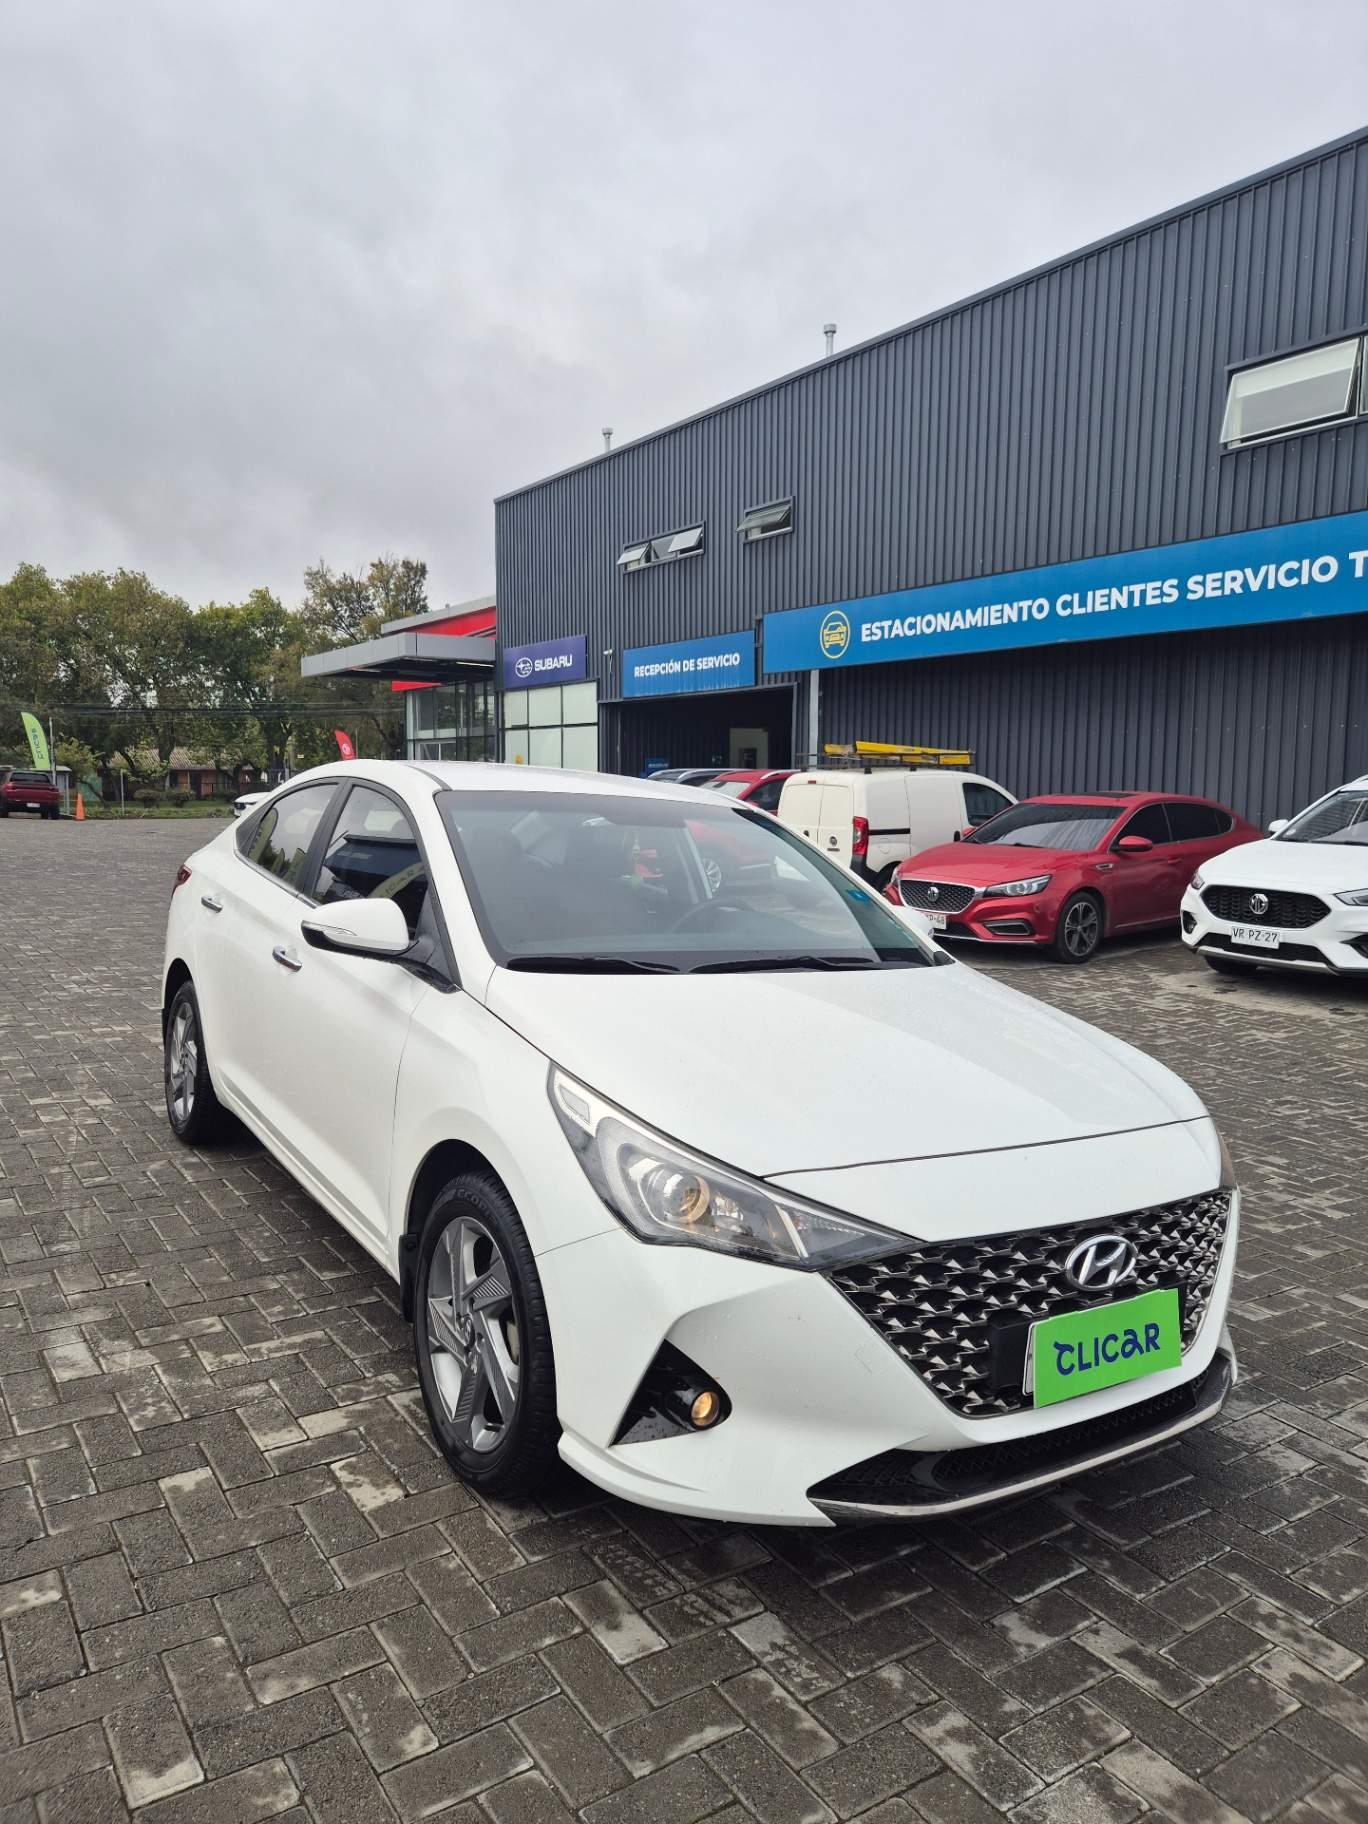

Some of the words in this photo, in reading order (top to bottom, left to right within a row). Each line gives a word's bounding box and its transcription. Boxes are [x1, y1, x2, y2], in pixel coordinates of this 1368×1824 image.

[861, 597, 1050, 642] ESTACIONAMIENTO
[1055, 578, 1179, 617] CLIENTES
[1186, 554, 1339, 600] SERVICIO
[534, 654, 573, 672] SUBARU
[634, 660, 681, 678] RECEPCIÓN
[683, 659, 696, 672] DE
[696, 653, 741, 670] SERVICIO
[1233, 928, 1245, 939] VR
